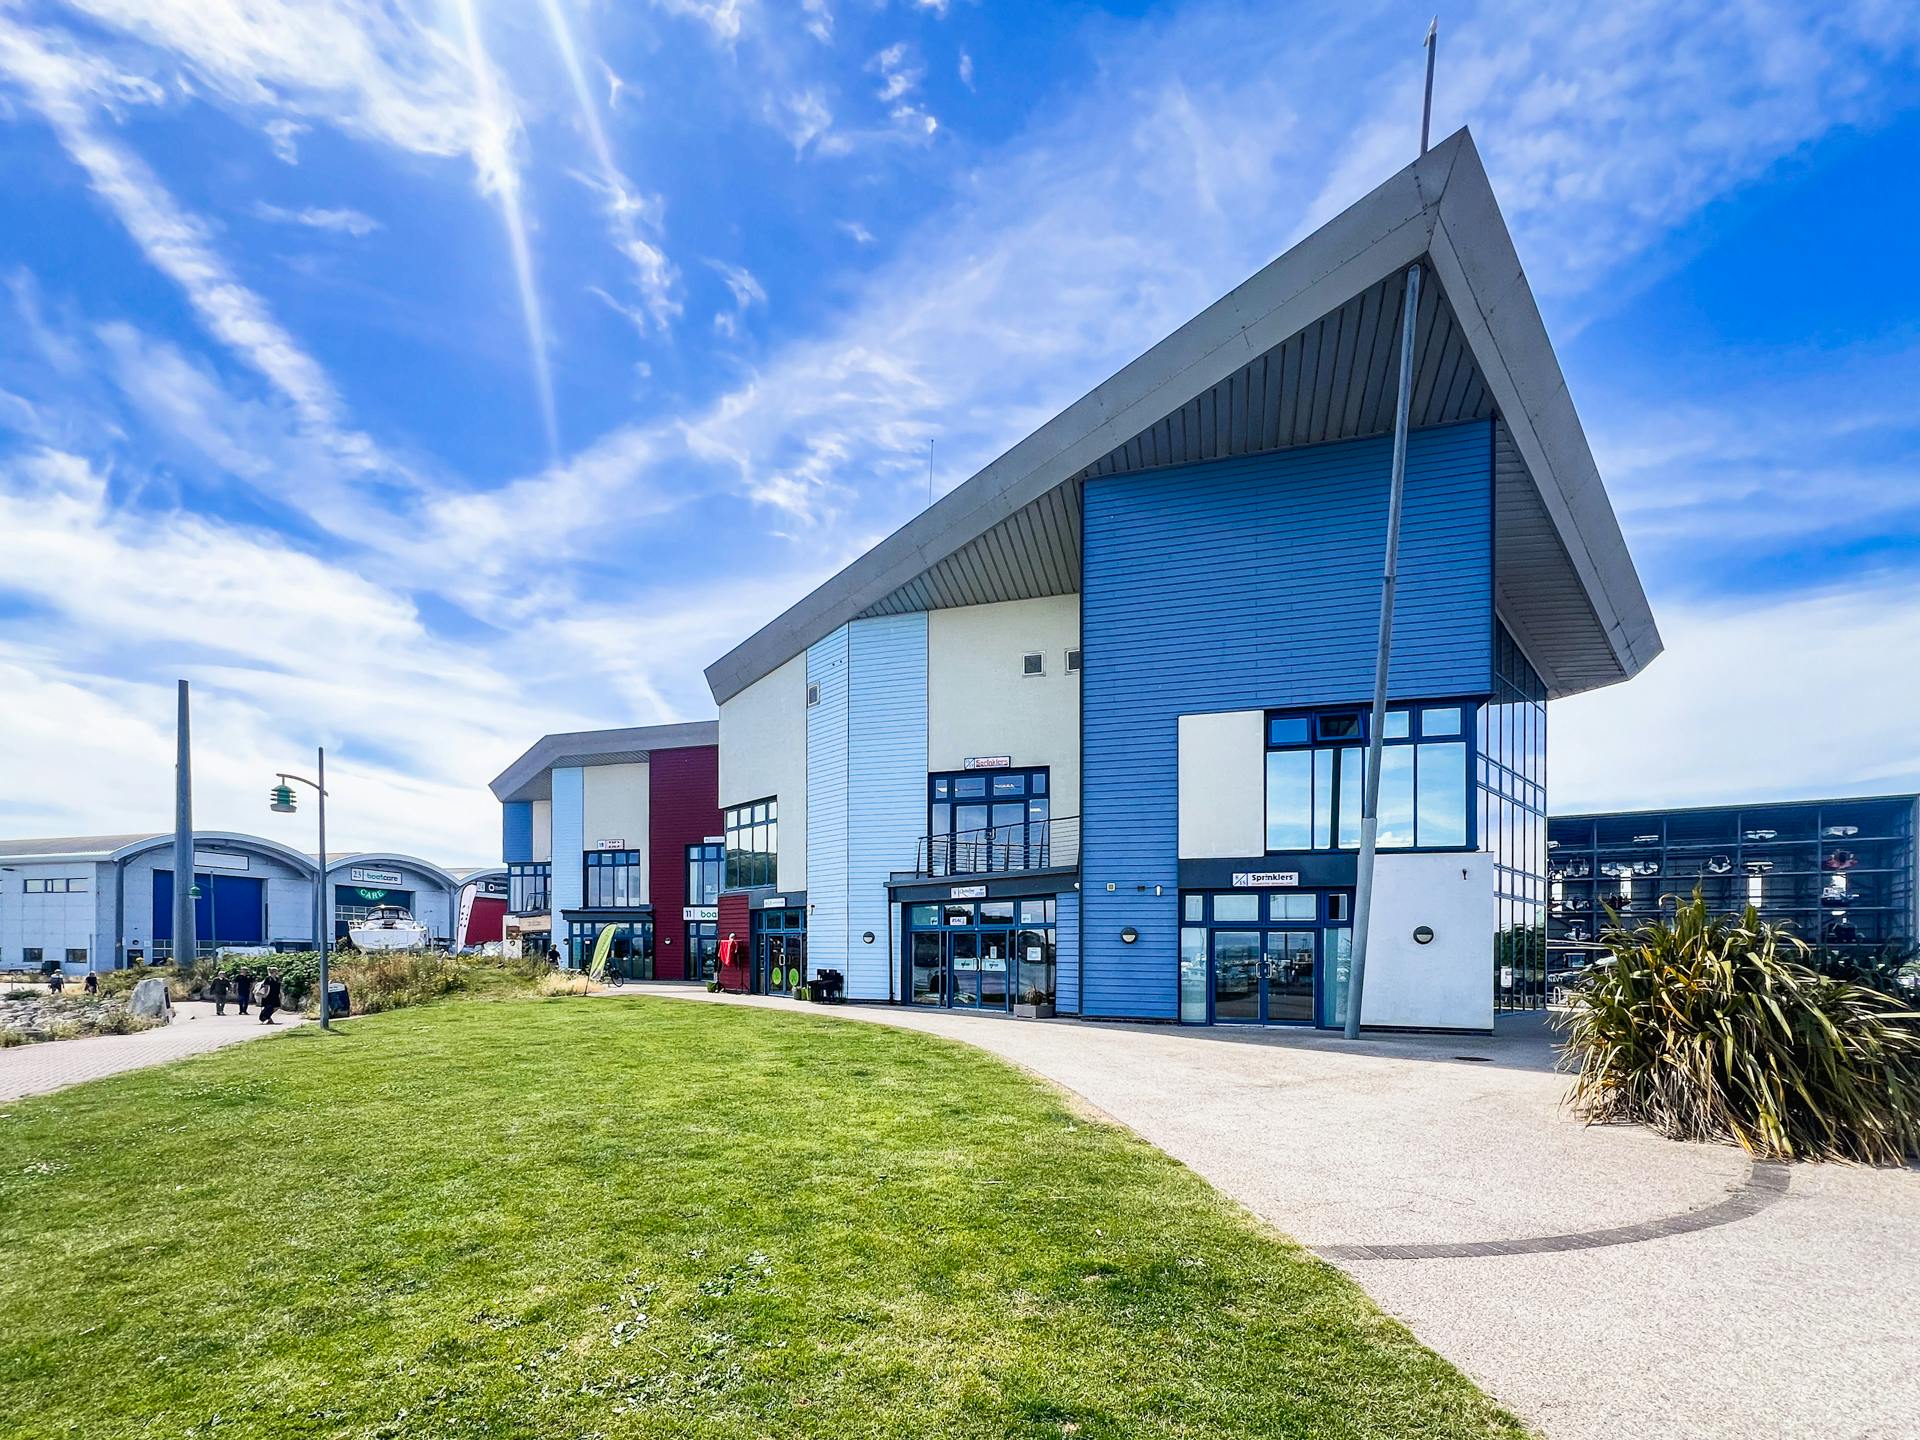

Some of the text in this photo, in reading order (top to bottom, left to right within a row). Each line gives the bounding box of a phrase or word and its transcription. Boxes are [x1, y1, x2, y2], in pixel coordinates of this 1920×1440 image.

[367, 873, 398, 881] boatcare
[1252, 874, 1294, 882] Sprinklers
[360, 889, 385, 899] CARE
[686, 910, 692, 918] 11
